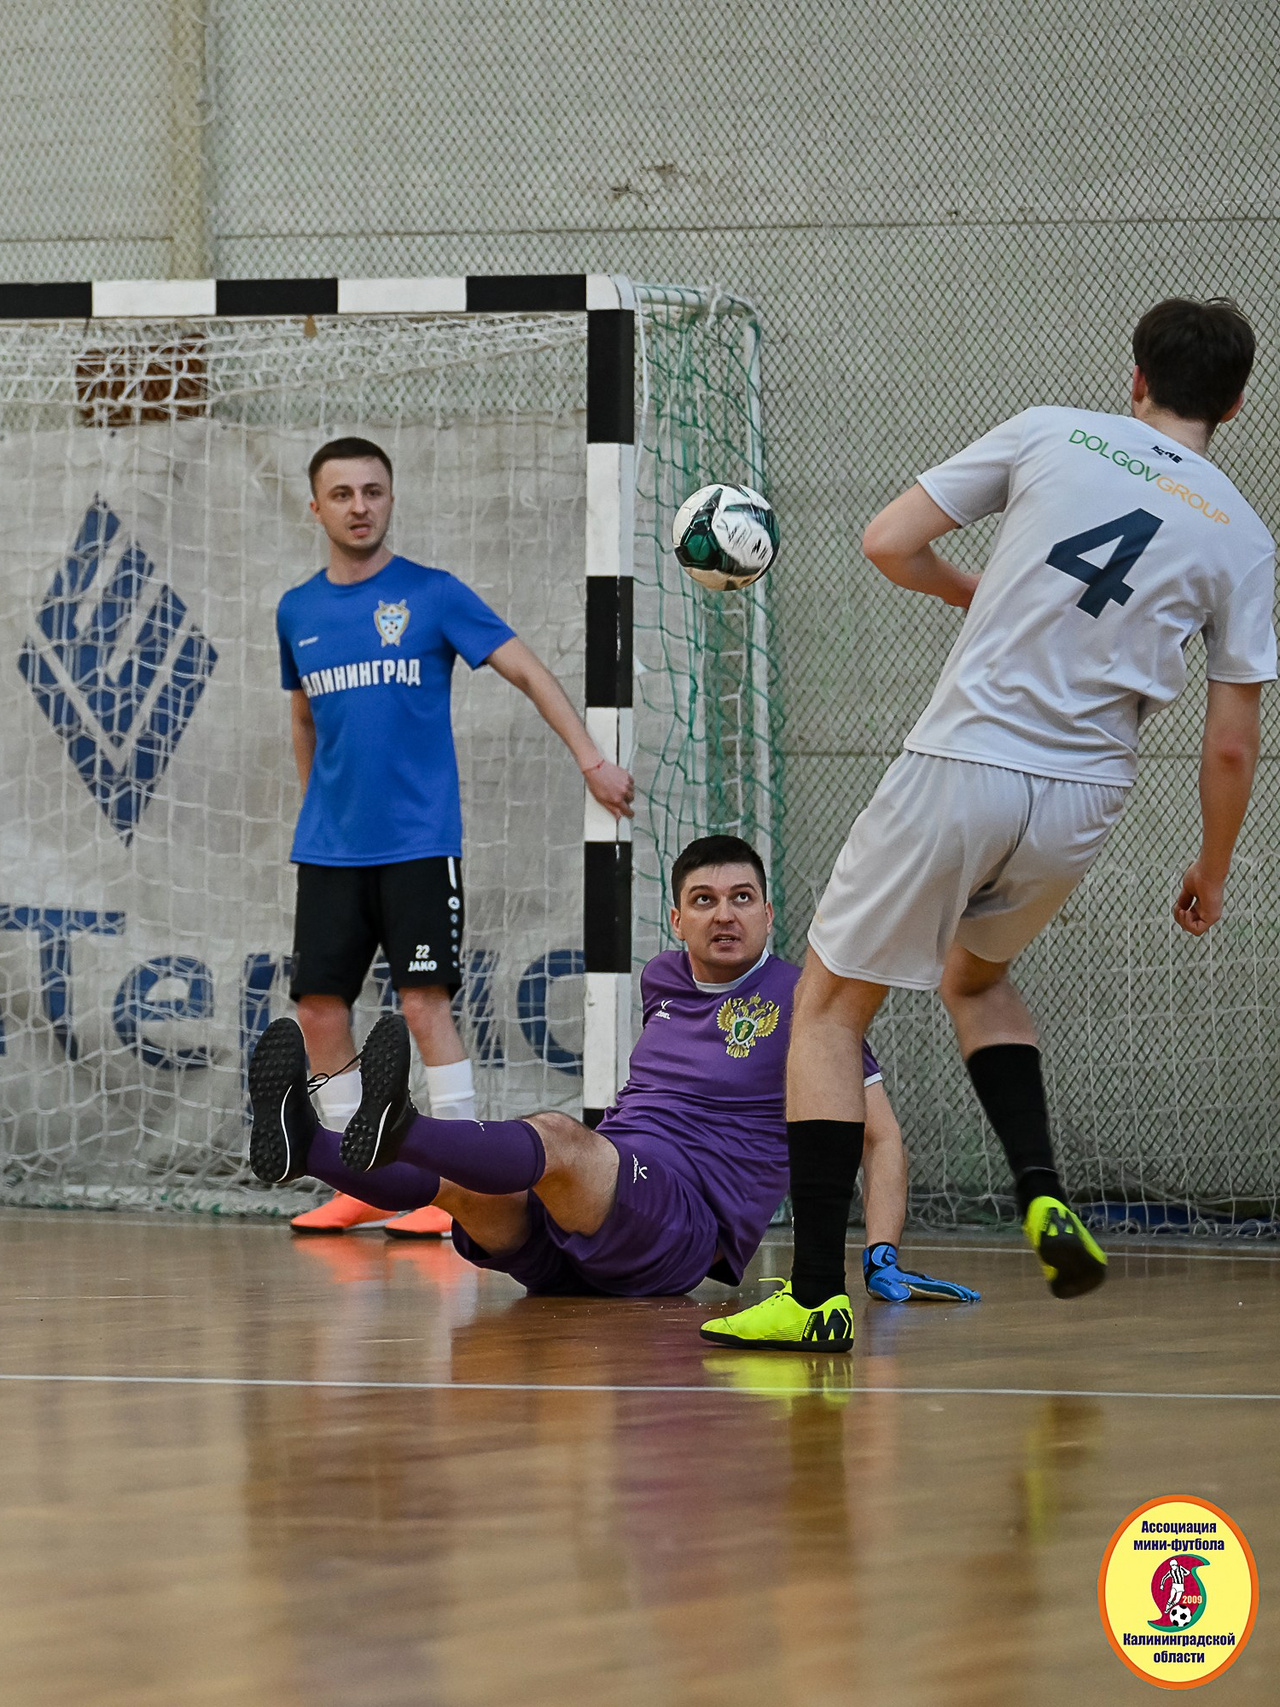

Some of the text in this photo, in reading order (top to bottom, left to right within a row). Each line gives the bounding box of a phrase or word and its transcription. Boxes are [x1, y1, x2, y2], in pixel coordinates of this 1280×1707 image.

[1045, 507, 1164, 619] 4
[300, 658, 421, 698] АЛИНИНГРАД
[415, 944, 430, 959] 22
[408, 960, 438, 972] JAKO
